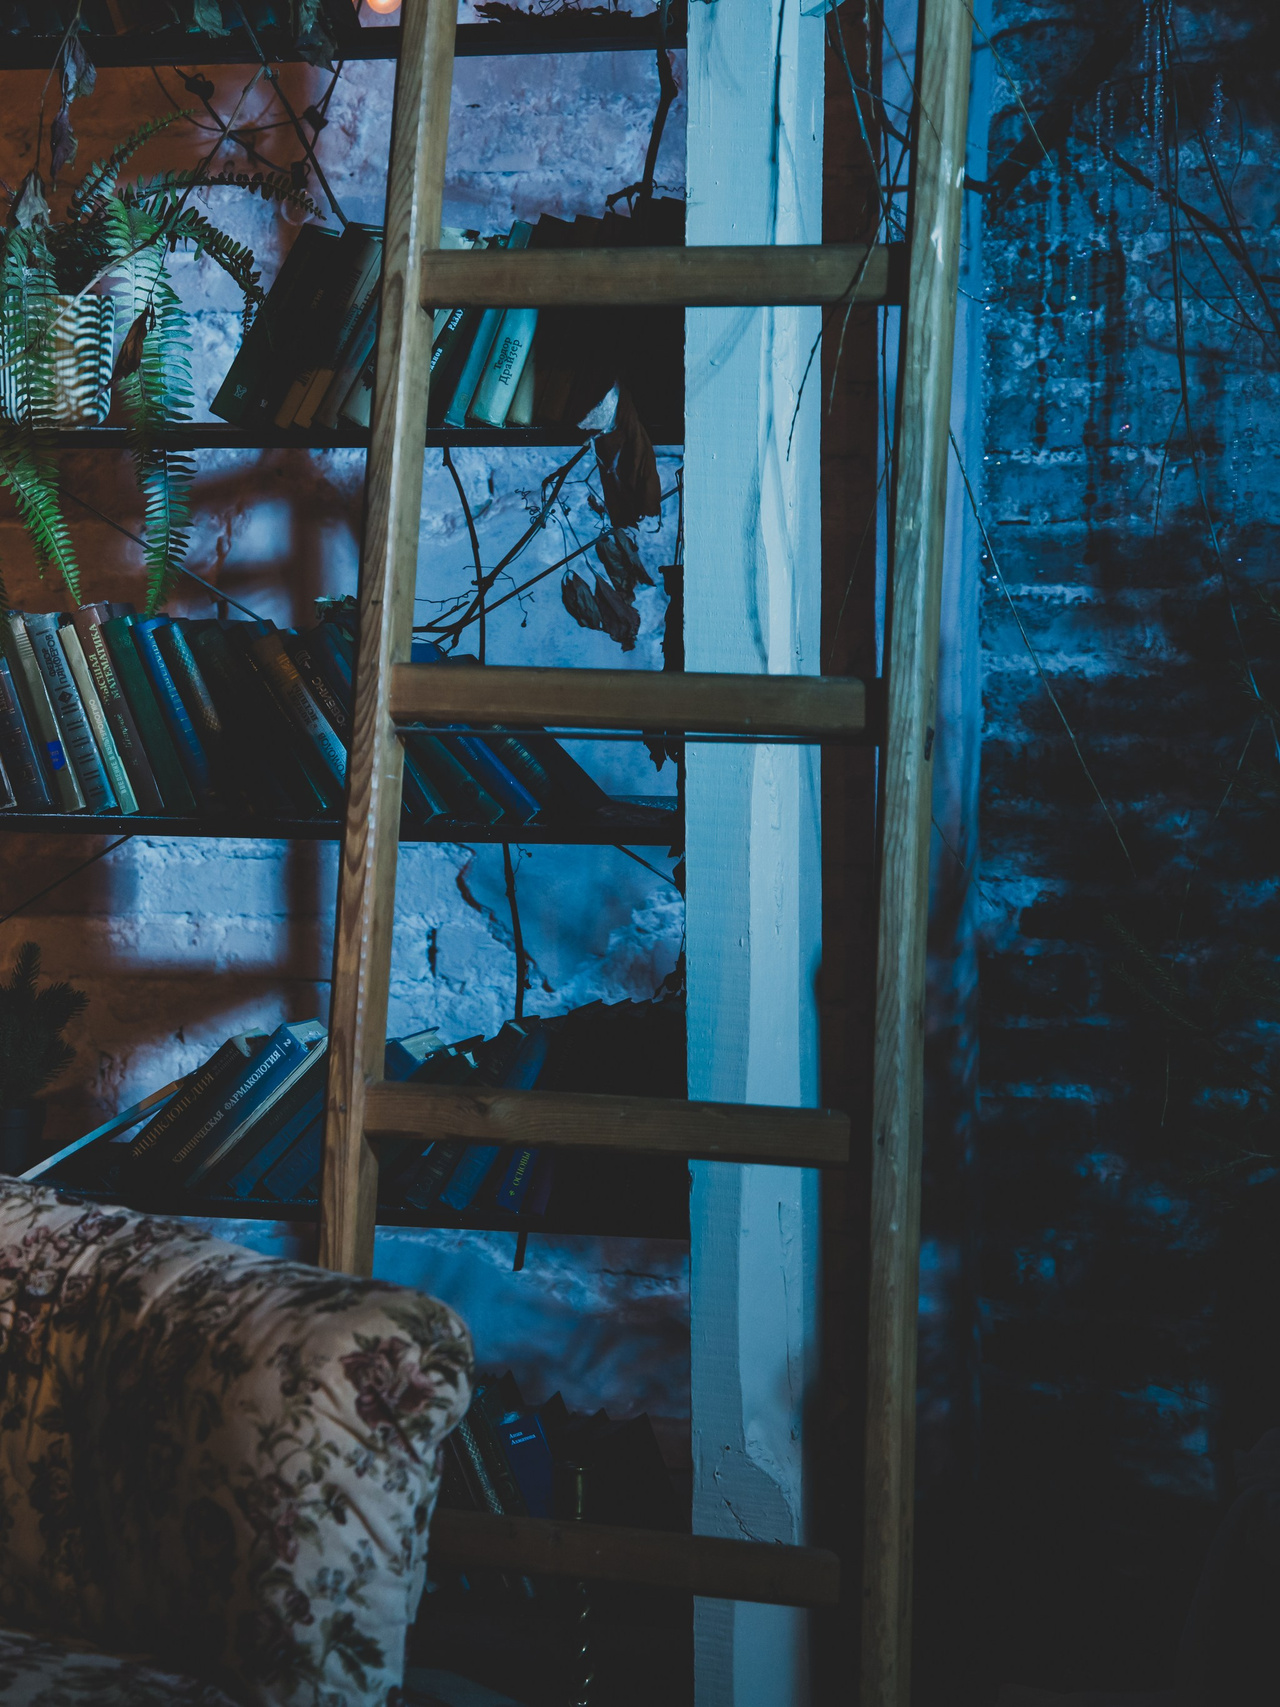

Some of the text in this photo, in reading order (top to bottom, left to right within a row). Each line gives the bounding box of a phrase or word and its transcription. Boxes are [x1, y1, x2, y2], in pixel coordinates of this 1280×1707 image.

[447, 307, 464, 330] РАЗДУ
[494, 336, 513, 371] Теодор
[497, 338, 523, 385] Драйзер
[43, 648, 57, 677] ФЕДОР
[45, 634, 68, 684] ПАНФЕРОВ
[89, 622, 120, 700] МАТЕМАТИКА
[86, 698, 114, 755] КУЛЬТУРОЛОГИЮ
[109, 760, 127, 794] ВВЕДЕНИЕ
[131, 1073, 216, 1160] ЭНЦИКЛОПЕДИЯ
[171, 1109, 225, 1164] КЛИНИЧЕСКАЯ
[223, 1049, 281, 1110] ФАРМАКОЛОГИЯ
[282, 1038, 292, 1047] 2
[512, 1151, 531, 1187] ОСНОВЫ
